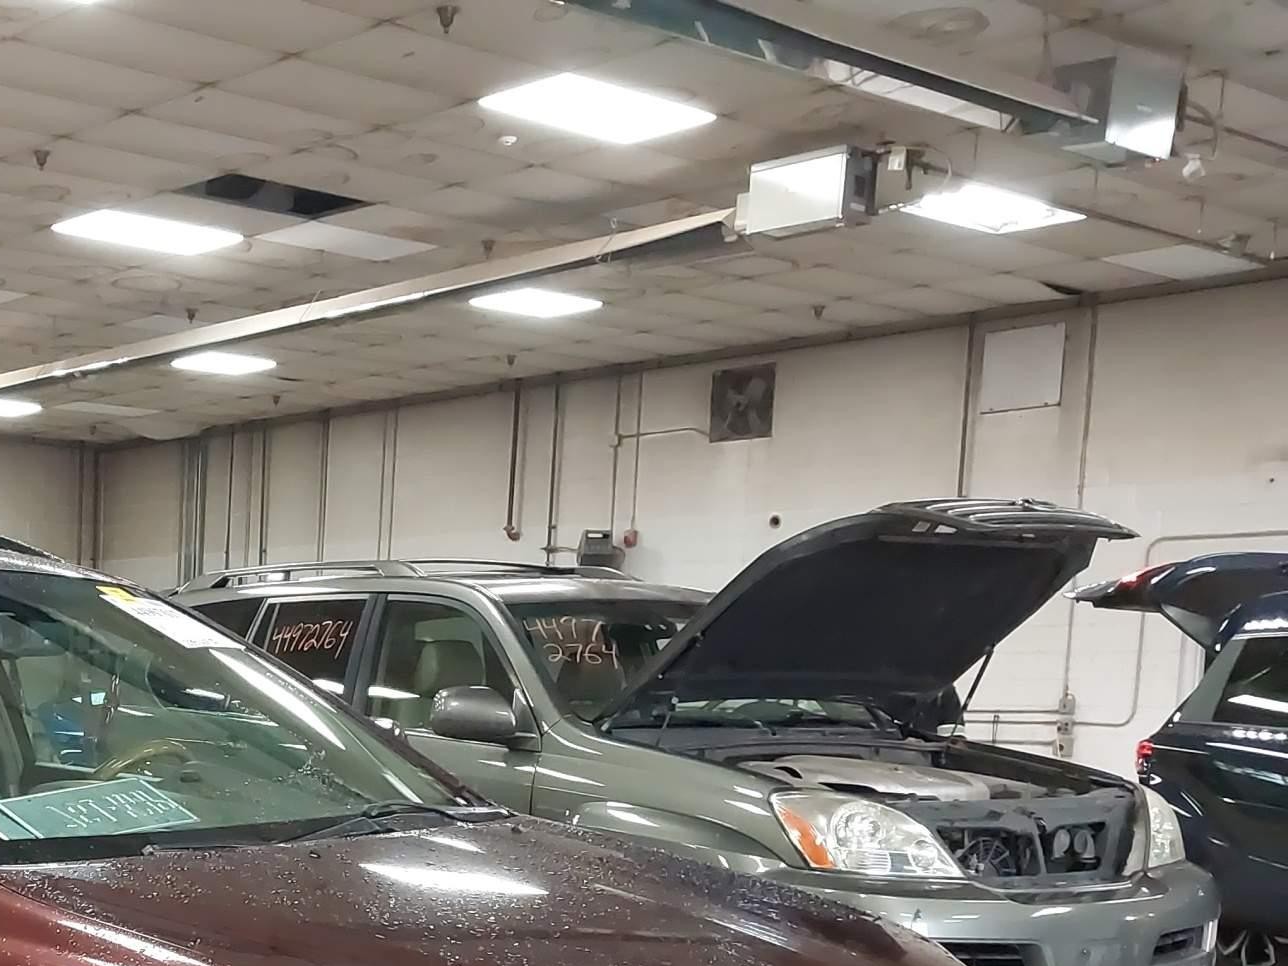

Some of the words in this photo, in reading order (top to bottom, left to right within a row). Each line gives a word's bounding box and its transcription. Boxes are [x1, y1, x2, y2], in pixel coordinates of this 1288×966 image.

[272, 620, 353, 660] 44972764
[523, 616, 606, 642] 4497
[543, 643, 618, 669] 2764
